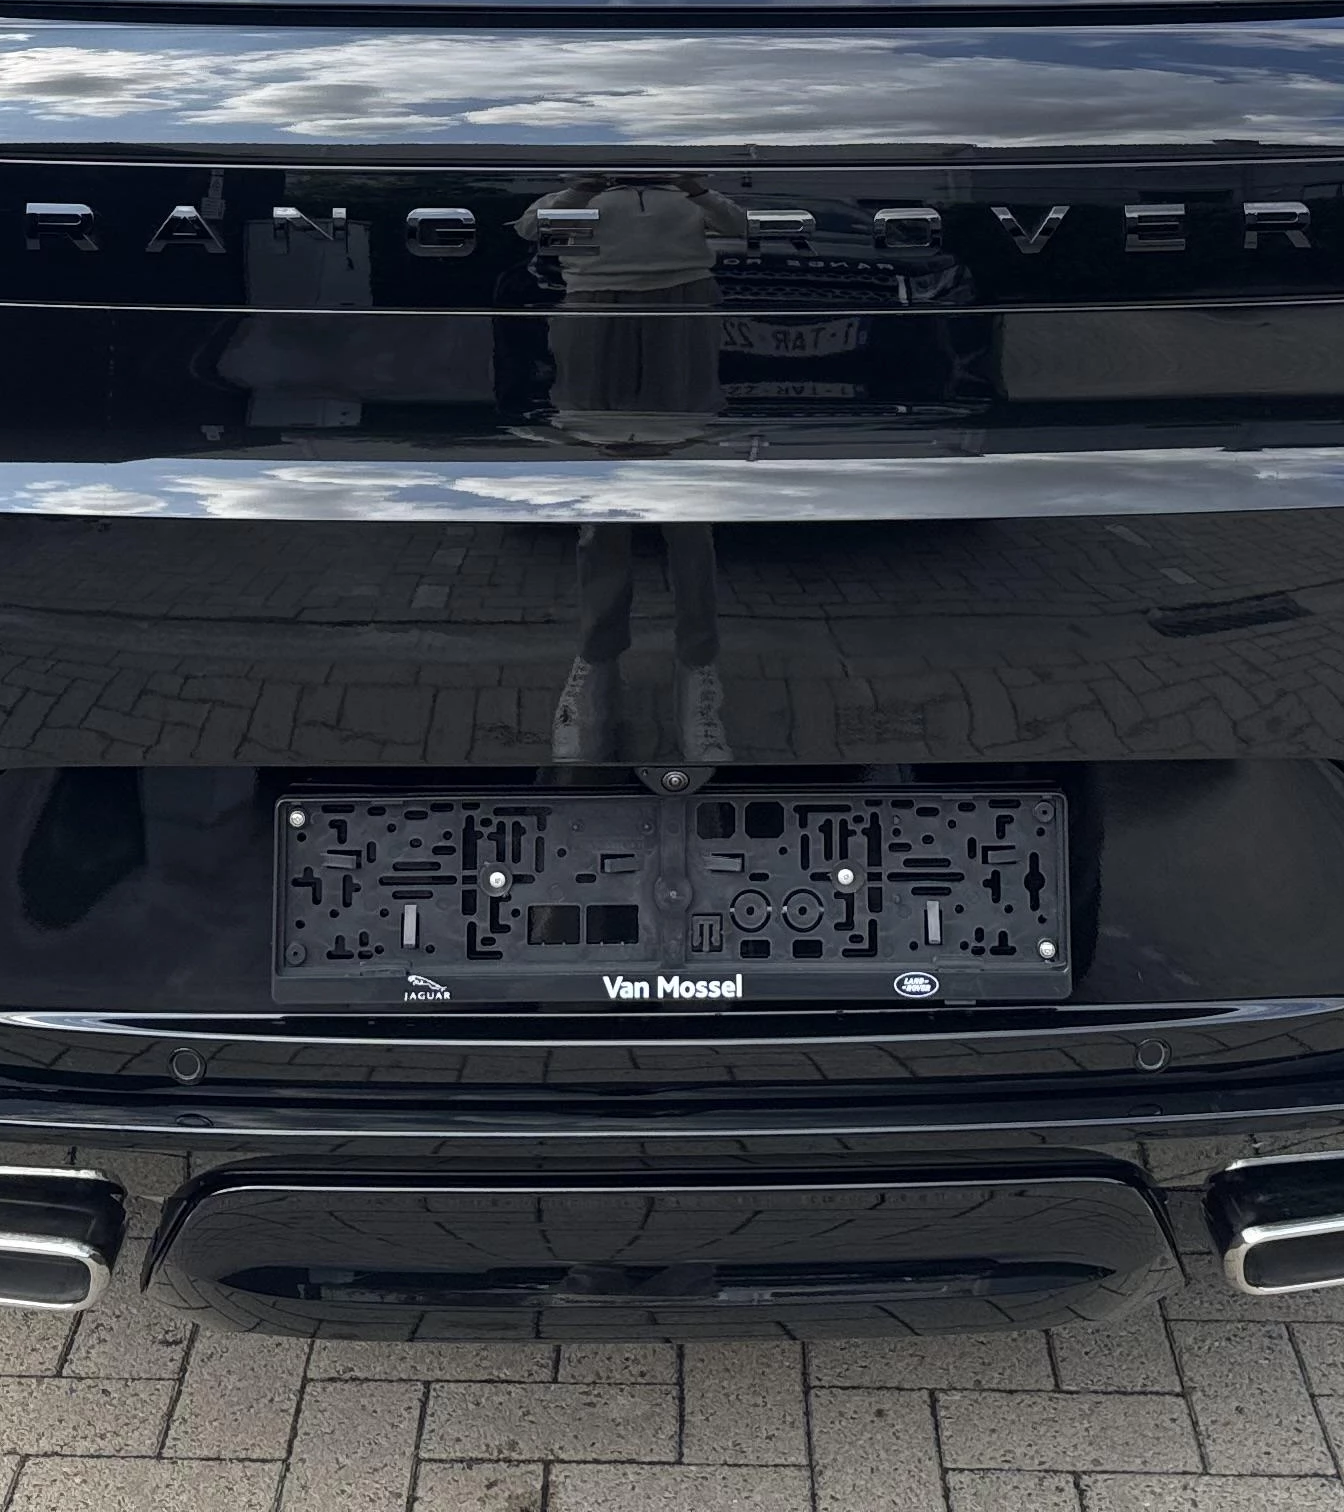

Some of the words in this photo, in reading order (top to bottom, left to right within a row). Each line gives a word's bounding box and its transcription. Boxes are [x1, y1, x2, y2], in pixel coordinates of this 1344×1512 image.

[25, 201, 602, 257] RANGE
[746, 201, 1312, 255] ROVER
[404, 991, 452, 1003] JAGUAR
[602, 975, 650, 999] Van
[657, 973, 743, 999] Mossel
